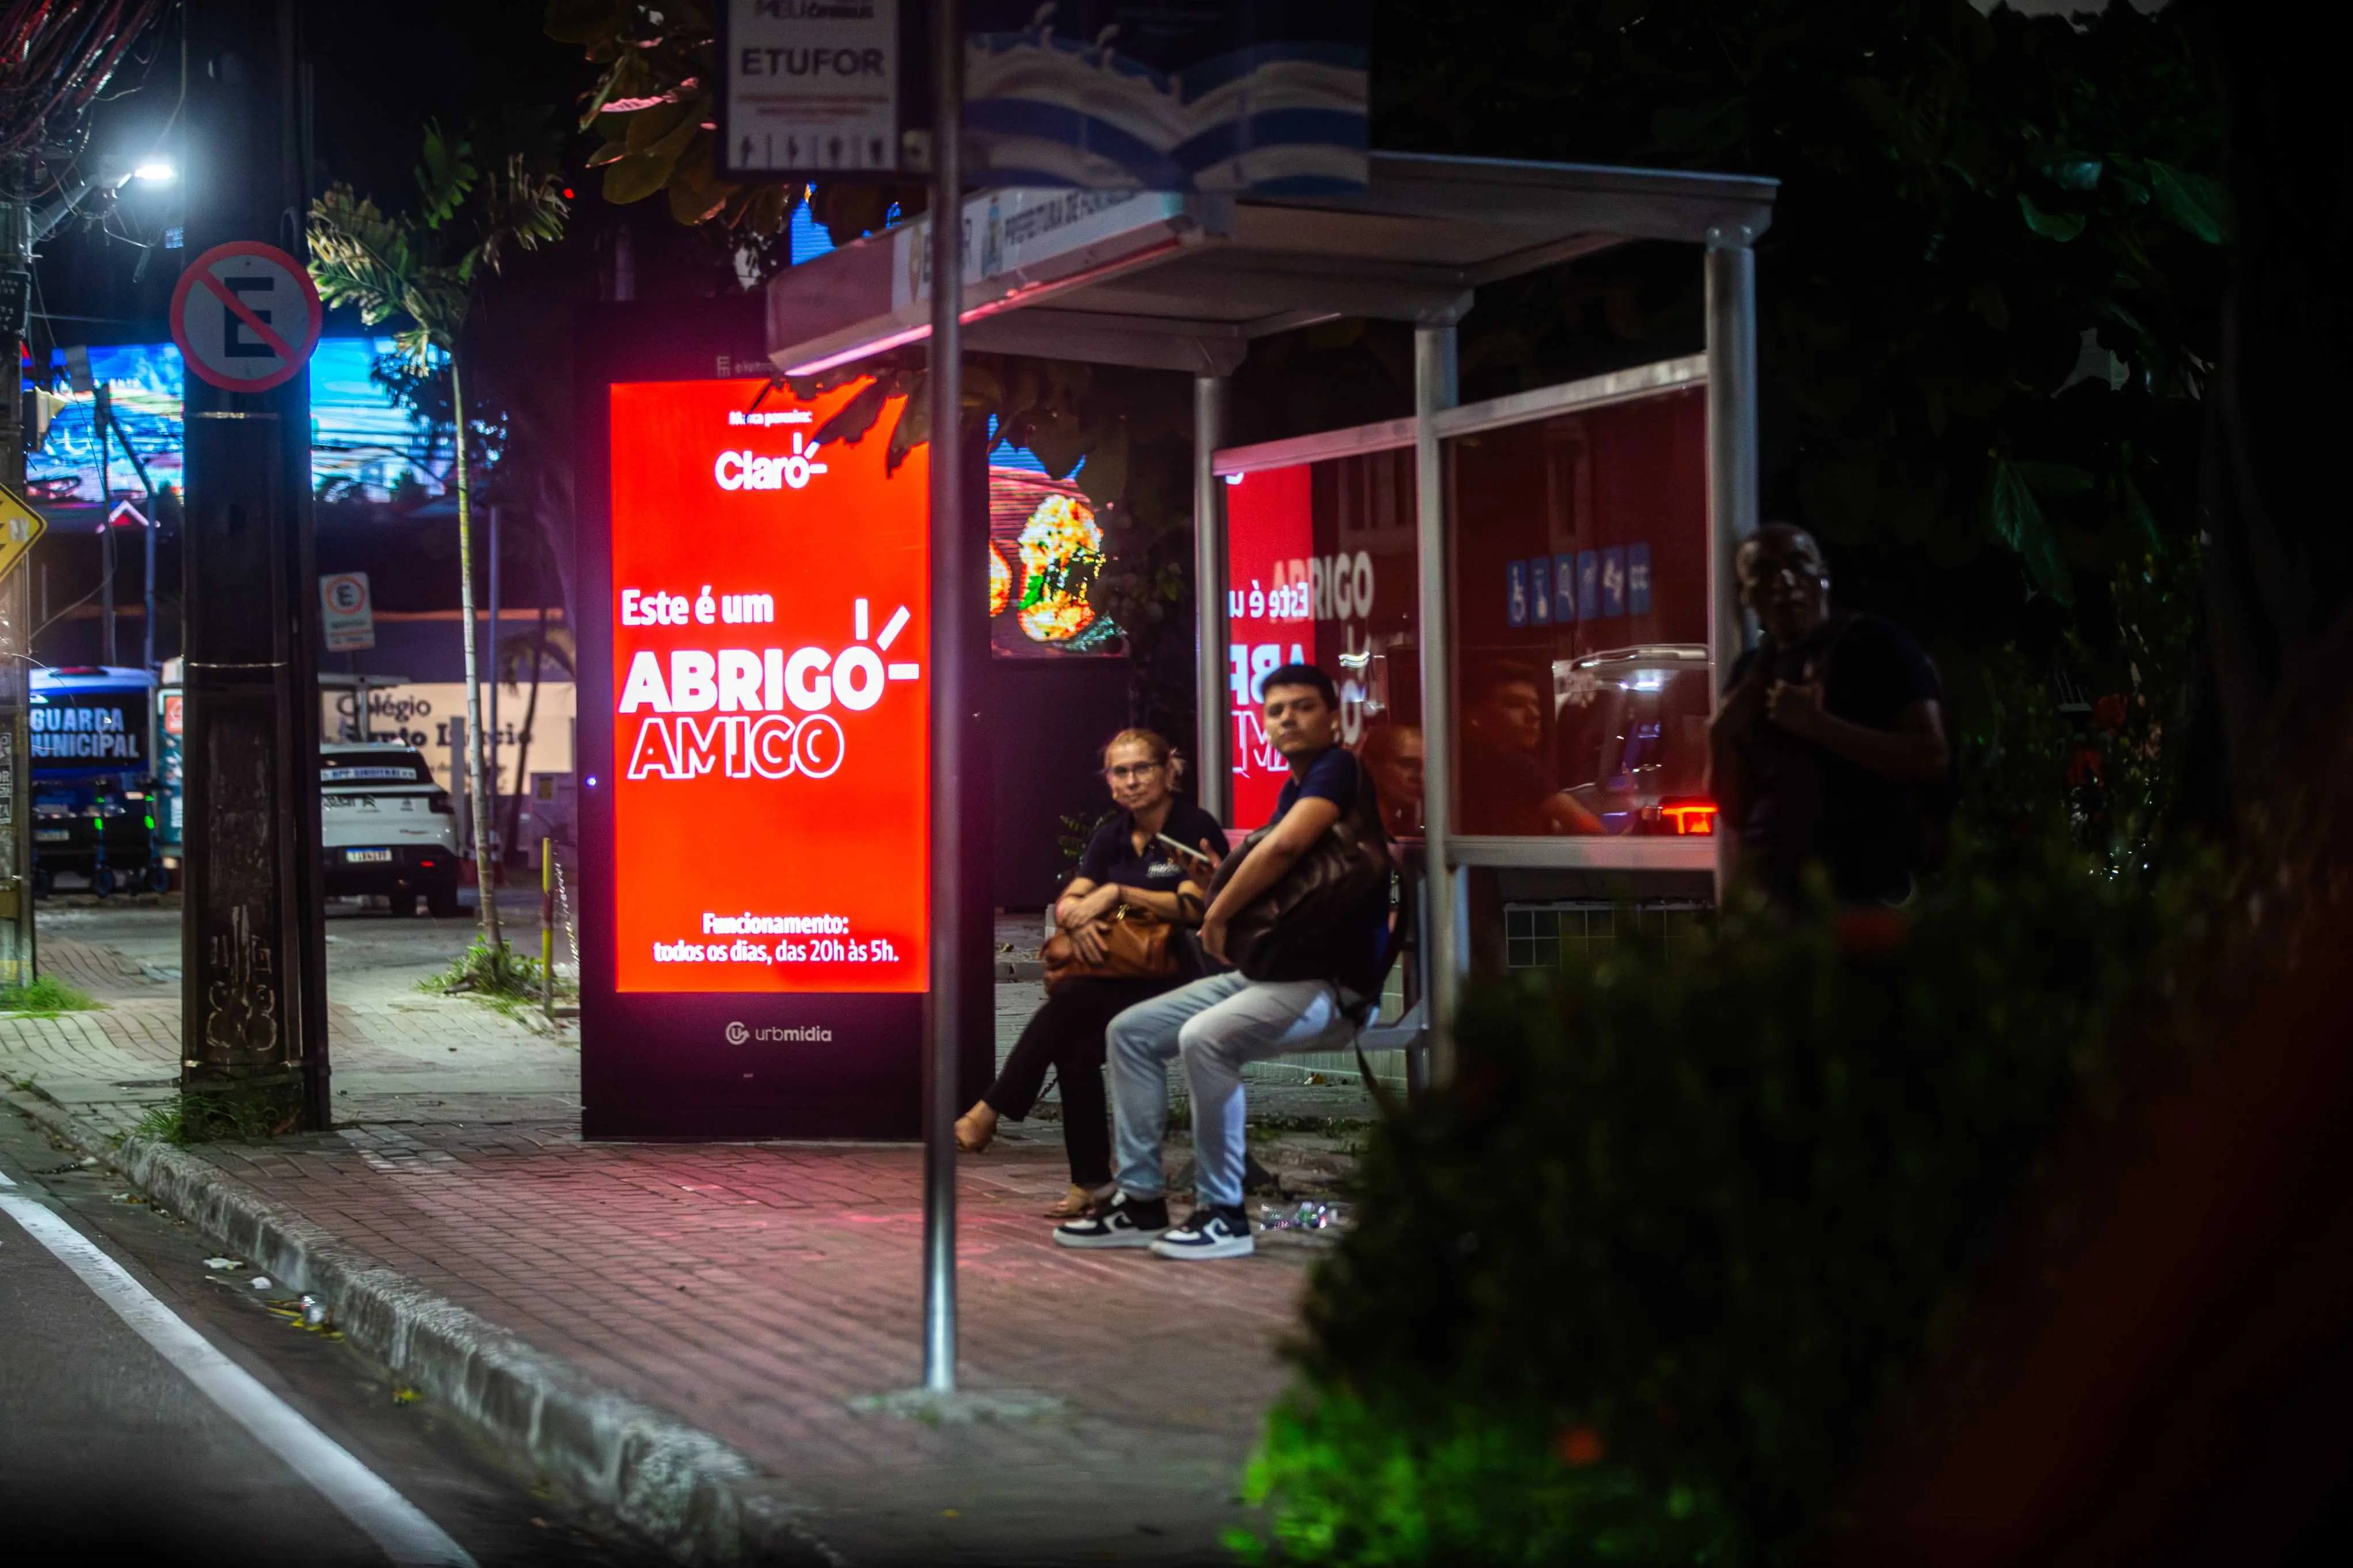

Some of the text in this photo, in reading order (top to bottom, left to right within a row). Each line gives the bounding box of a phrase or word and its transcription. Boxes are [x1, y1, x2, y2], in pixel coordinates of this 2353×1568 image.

[741, 47, 885, 77] ETUFOR
[224, 277, 276, 357] E
[714, 450, 810, 490] Claro
[336, 584, 353, 607] E
[622, 585, 774, 625] Este é um
[618, 646, 885, 714] ABRIGO
[30, 708, 124, 732] GUARDA
[627, 714, 845, 780] AMIGO
[702, 912, 849, 934] Funcionamento:
[653, 938, 900, 966] todos os dias, das 20h às 5h.
[755, 1026, 832, 1042] urbmidia
